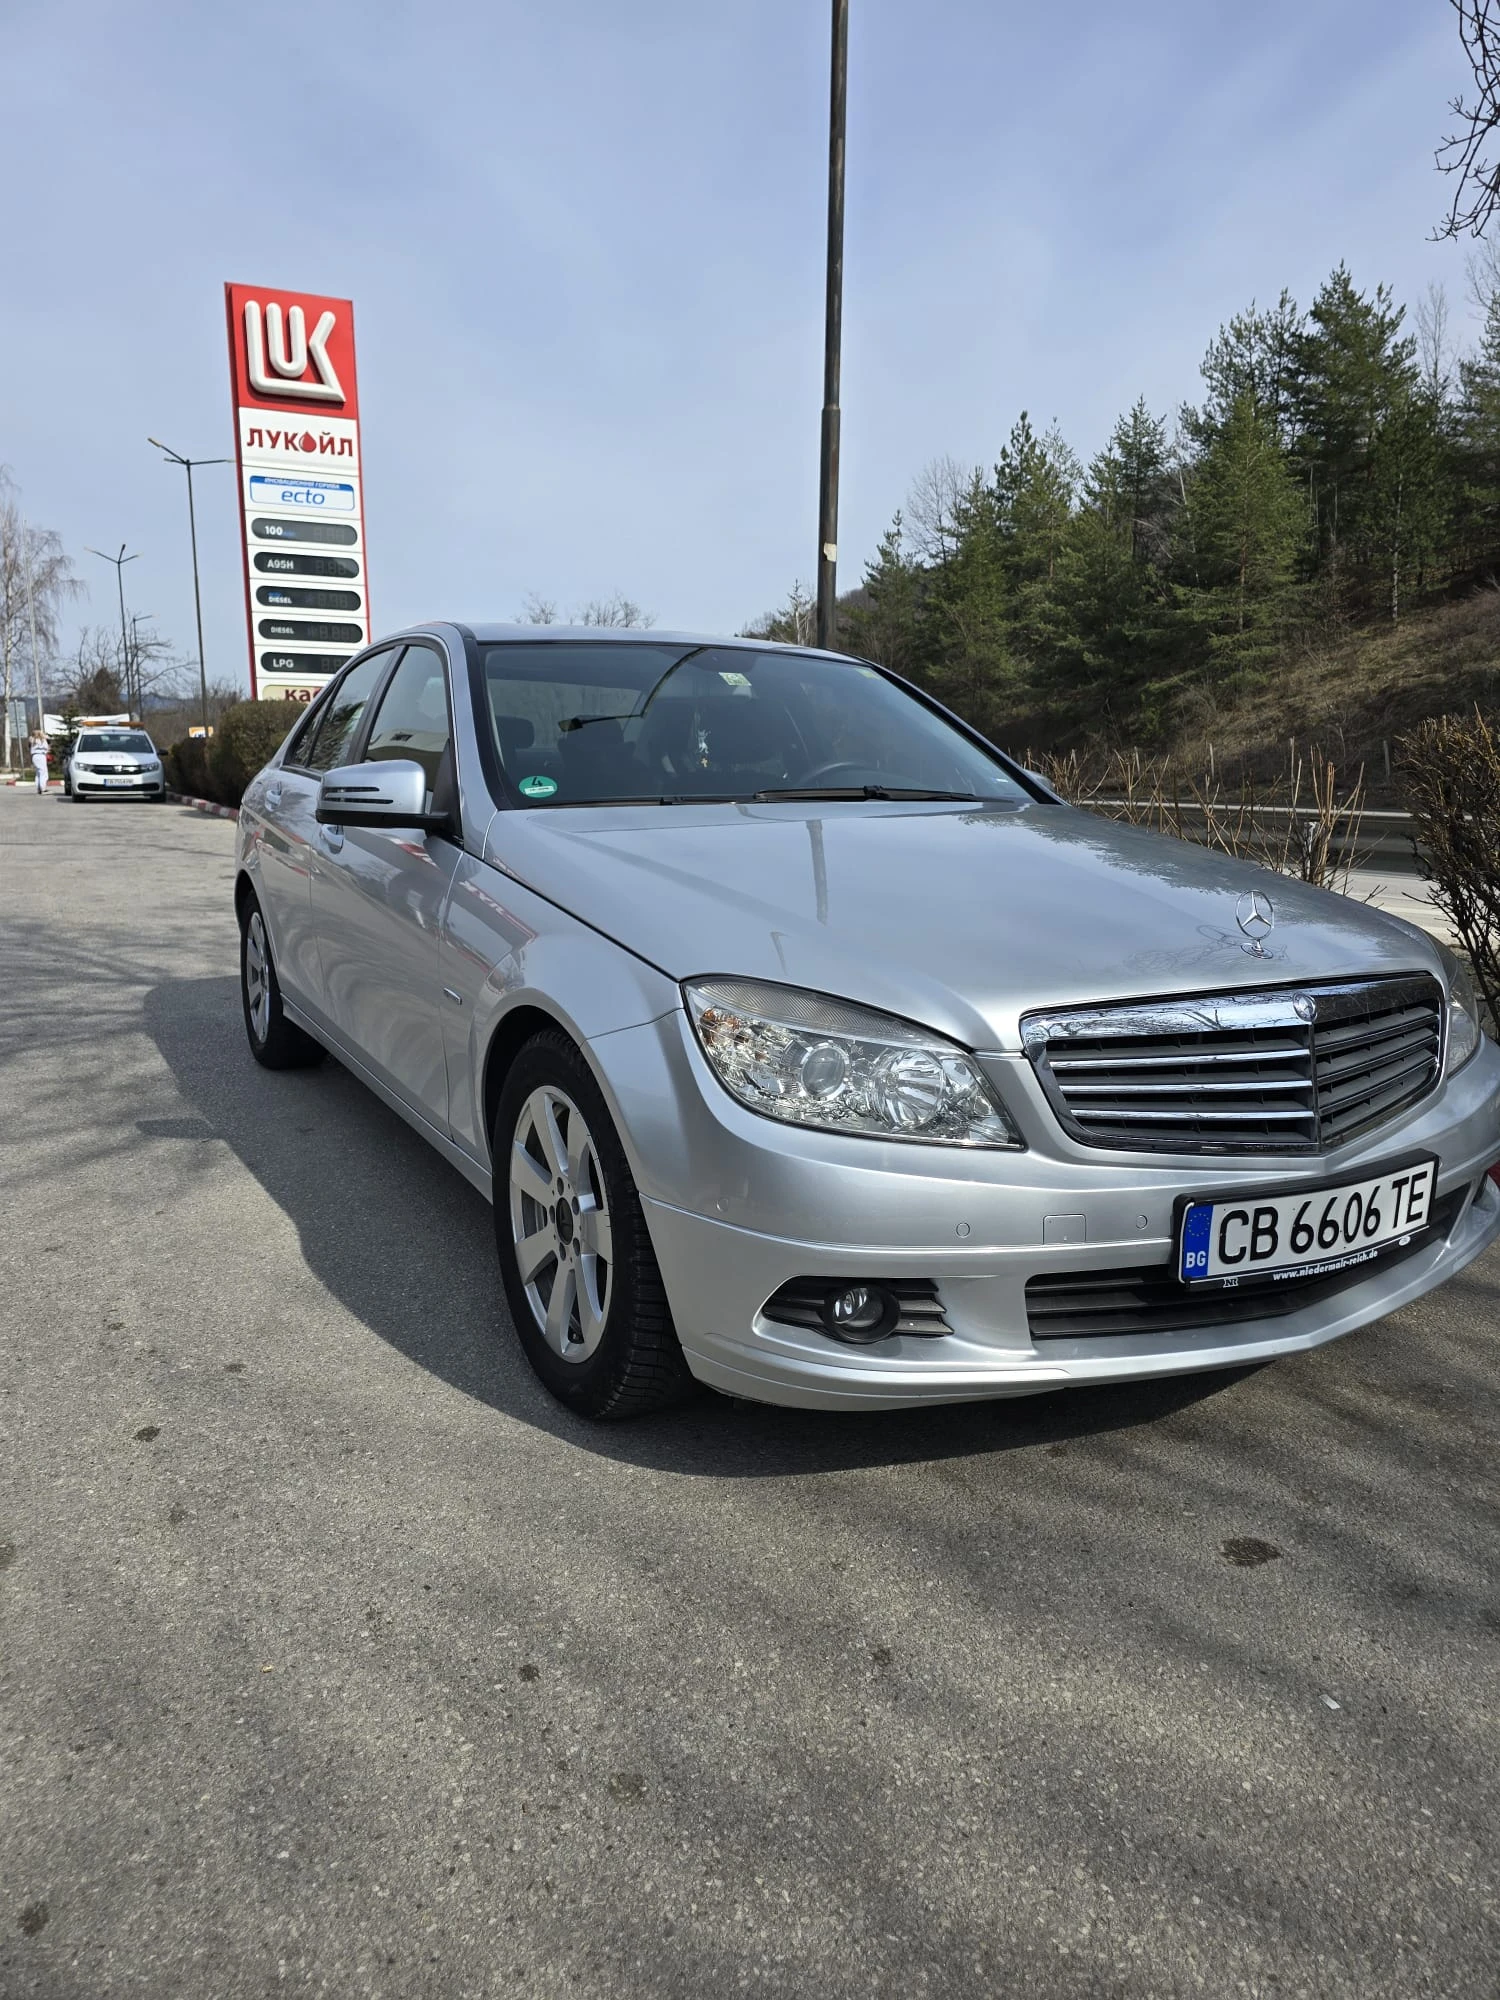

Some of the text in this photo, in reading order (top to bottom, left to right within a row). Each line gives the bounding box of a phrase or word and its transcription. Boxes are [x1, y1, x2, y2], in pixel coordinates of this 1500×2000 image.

[281, 489, 325, 505] ecto
[265, 525, 283, 536] 100
[267, 559, 294, 570] A95H
[270, 626, 294, 634] DIESEL
[272, 659, 294, 668] LPG
[532, 776, 543, 786] 4
[1218, 1170, 1428, 1265] CB 6606 TE
[1185, 1250, 1207, 1268] BG
[1272, 1249, 1379, 1280] www.niedermair-reich.de
